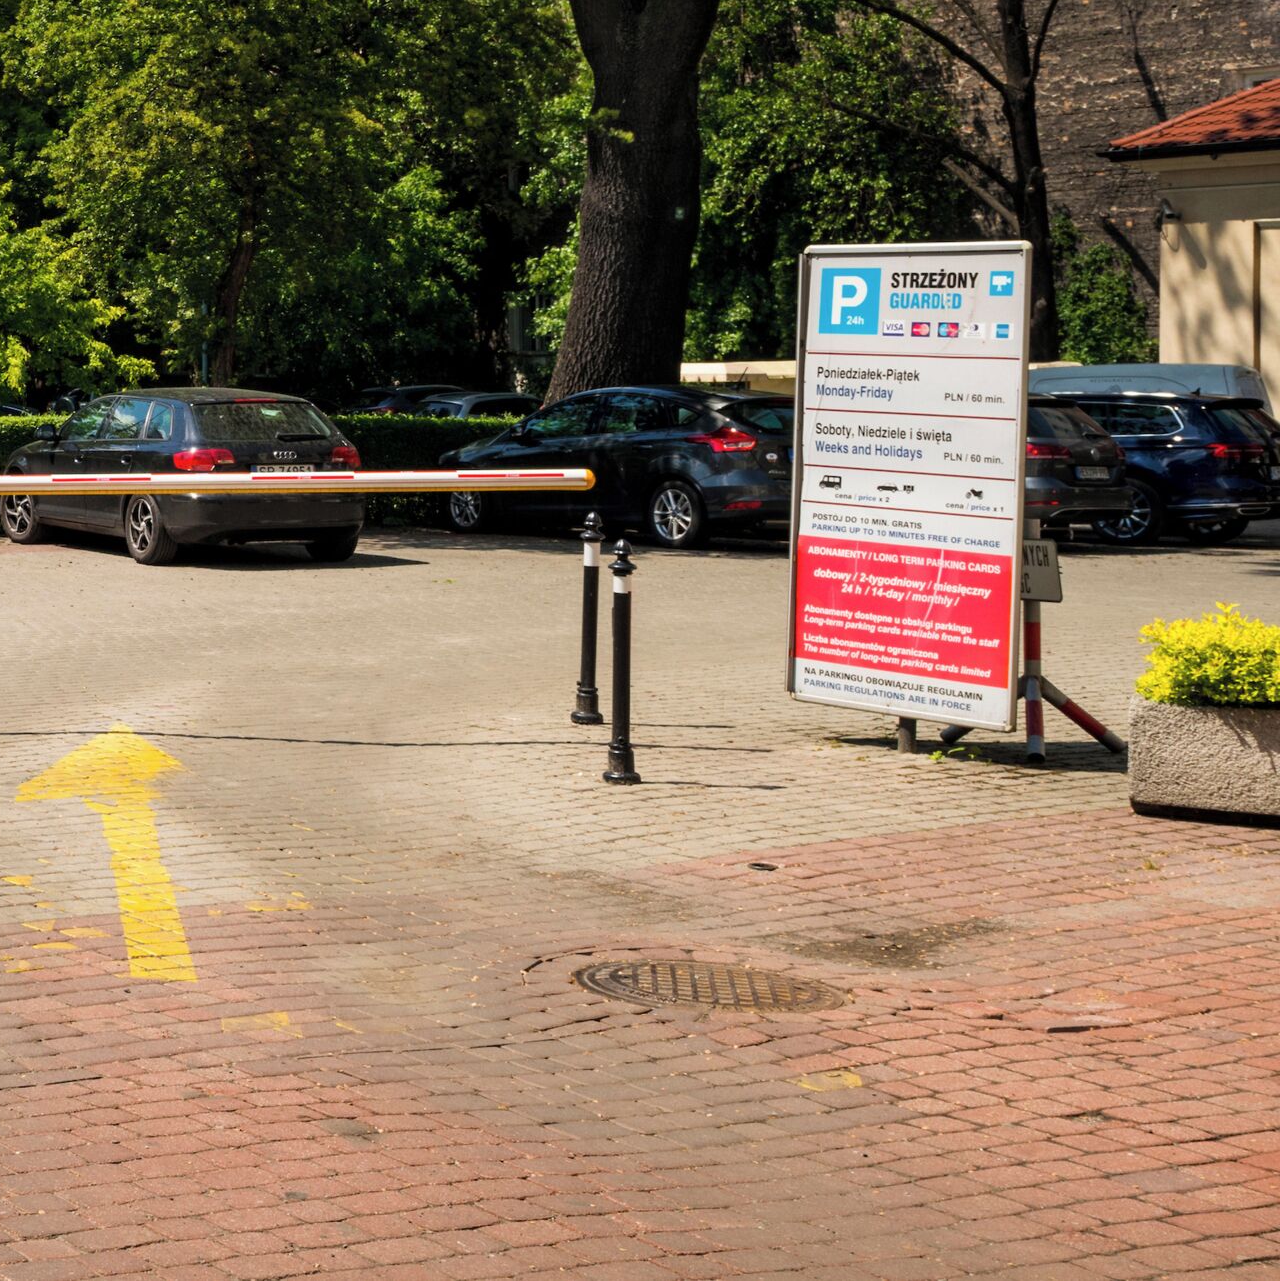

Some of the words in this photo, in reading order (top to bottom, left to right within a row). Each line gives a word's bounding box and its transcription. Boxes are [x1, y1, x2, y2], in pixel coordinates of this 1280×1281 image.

[890, 269, 978, 289] STRZEŻONY
[831, 275, 868, 325] P
[846, 315, 864, 325] 24h
[886, 323, 904, 331] VISA
[817, 367, 920, 384] Poniedziałek-Piątek
[816, 384, 894, 401] Monday-Friday
[944, 393, 964, 401] PLN
[972, 394, 982, 403] 60
[985, 395, 1005, 403] min.
[816, 423, 854, 439] Soboty,
[858, 425, 906, 439] Niedziele
[916, 428, 952, 445] święta
[816, 441, 848, 454] Weeks
[852, 444, 872, 455] and
[875, 444, 922, 461] Holidays
[944, 453, 962, 461] PLN
[970, 454, 981, 463] 60
[984, 455, 1004, 464] min.
[971, 503, 990, 511] price
[845, 515, 857, 523] DO
[872, 518, 890, 526] MIN.
[892, 520, 922, 529] GRATIS
[812, 523, 847, 533] PARKING
[849, 526, 860, 534] UP
[888, 531, 925, 540] MINUTES
[928, 534, 948, 543] FREE
[950, 536, 961, 544] OF
[964, 538, 1000, 548] CHARGE
[808, 545, 867, 559] ABONAMENTY
[873, 552, 898, 563] LONG
[900, 555, 925, 566] TERM
[926, 558, 966, 571] PARKING
[968, 562, 1001, 574] CARDS
[814, 568, 852, 582] dobowy
[860, 573, 926, 591] 2-tygodniowy
[933, 582, 992, 599] miesięczny
[841, 583, 853, 593] 24
[855, 585, 862, 594] h
[872, 588, 904, 602] 14-day
[912, 593, 953, 607] monthly
[804, 604, 853, 620] Abonamenty
[854, 611, 892, 623] dostępne
[935, 622, 972, 635] parkingu
[804, 615, 844, 626] Long-term
[845, 621, 876, 633] parking
[877, 625, 900, 635] cards
[902, 629, 940, 640] available
[941, 633, 960, 643] from
[963, 636, 977, 645] the
[978, 638, 1000, 648] staff
[803, 633, 828, 644] Liczba
[830, 637, 886, 652] abonamentów
[887, 646, 938, 659] ograniczona
[804, 643, 818, 653] The
[820, 647, 850, 657] number
[851, 651, 859, 659] of
[861, 651, 900, 664] long-term
[901, 659, 934, 671] parking
[935, 663, 959, 673] cards
[960, 665, 991, 678] limited
[804, 667, 816, 675] NA
[819, 669, 863, 682] PARKINGU
[866, 676, 925, 692] OBOWIĄZUJE
[927, 685, 983, 701] REGULAMIN
[804, 679, 841, 691] PARKING
[844, 685, 905, 700] REGULATIONS
[908, 695, 926, 704] ARE
[930, 698, 939, 706] IN
[942, 700, 972, 711] FORCE
